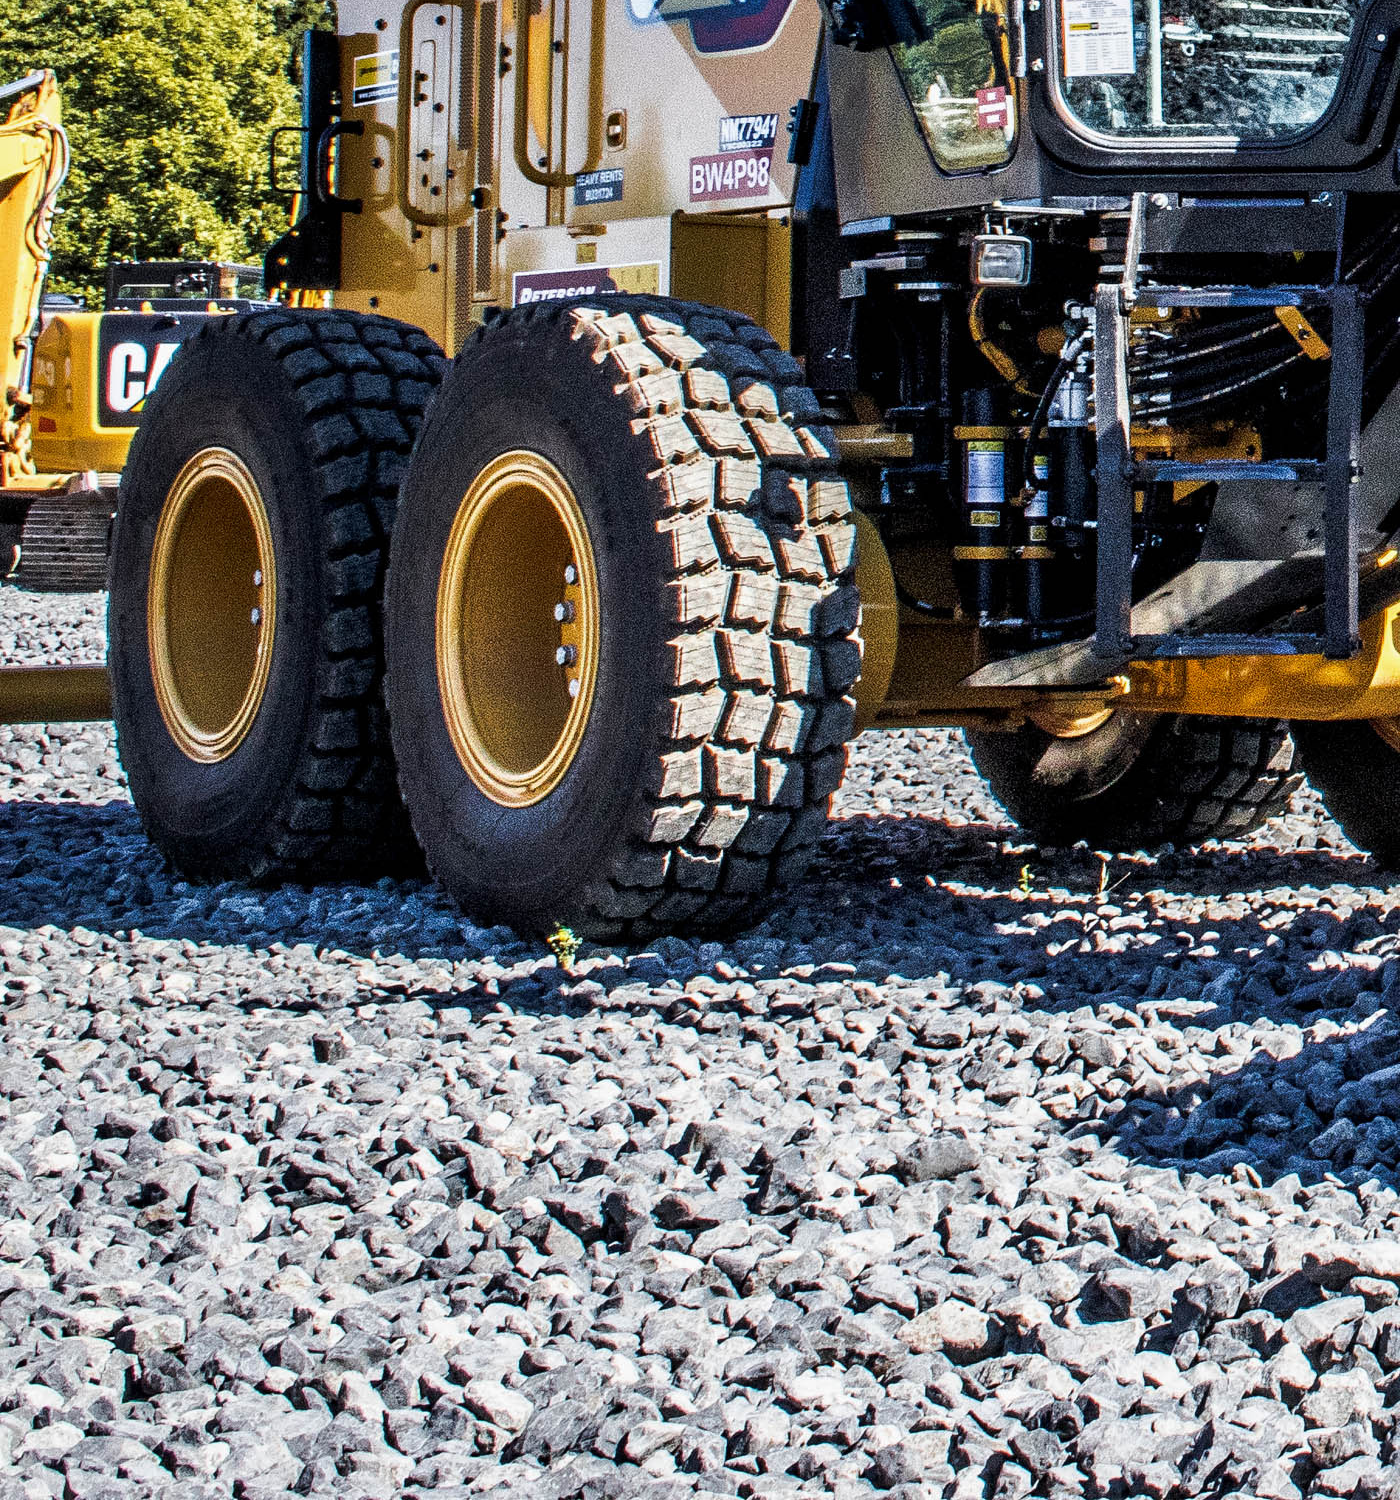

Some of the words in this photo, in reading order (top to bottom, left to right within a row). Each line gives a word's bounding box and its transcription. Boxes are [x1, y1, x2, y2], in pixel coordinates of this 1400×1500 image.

[720, 114, 779, 143] NM77941
[599, 169, 623, 184] RENTS
[692, 156, 770, 194] BW4P98
